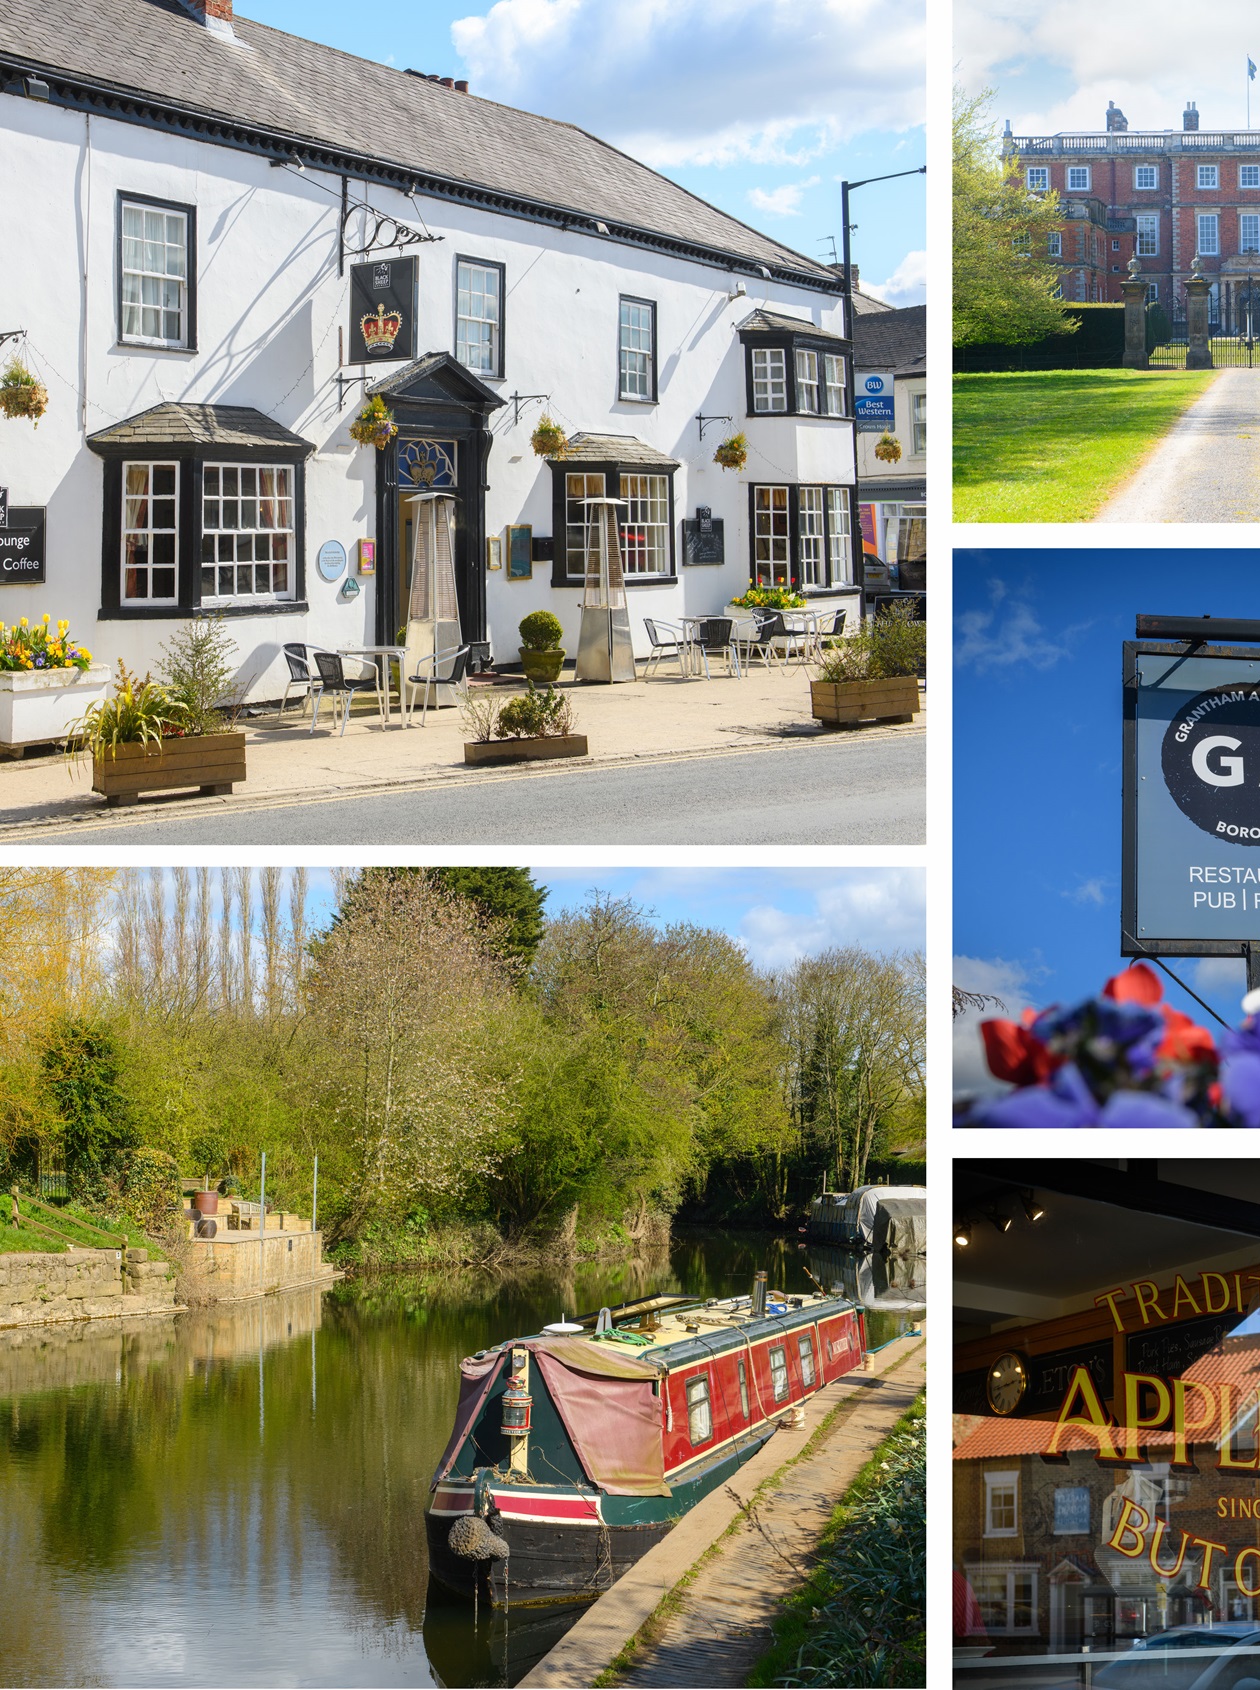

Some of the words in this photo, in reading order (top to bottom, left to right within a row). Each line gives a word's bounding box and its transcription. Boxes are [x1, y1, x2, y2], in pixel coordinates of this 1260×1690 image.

[867, 381, 882, 390] BW
[865, 400, 884, 408] Best
[858, 407, 892, 415] Western
[3, 557, 40, 571] Coffee
[1174, 690, 1245, 743] GRANTHAM
[1193, 891, 1236, 909] PUB
